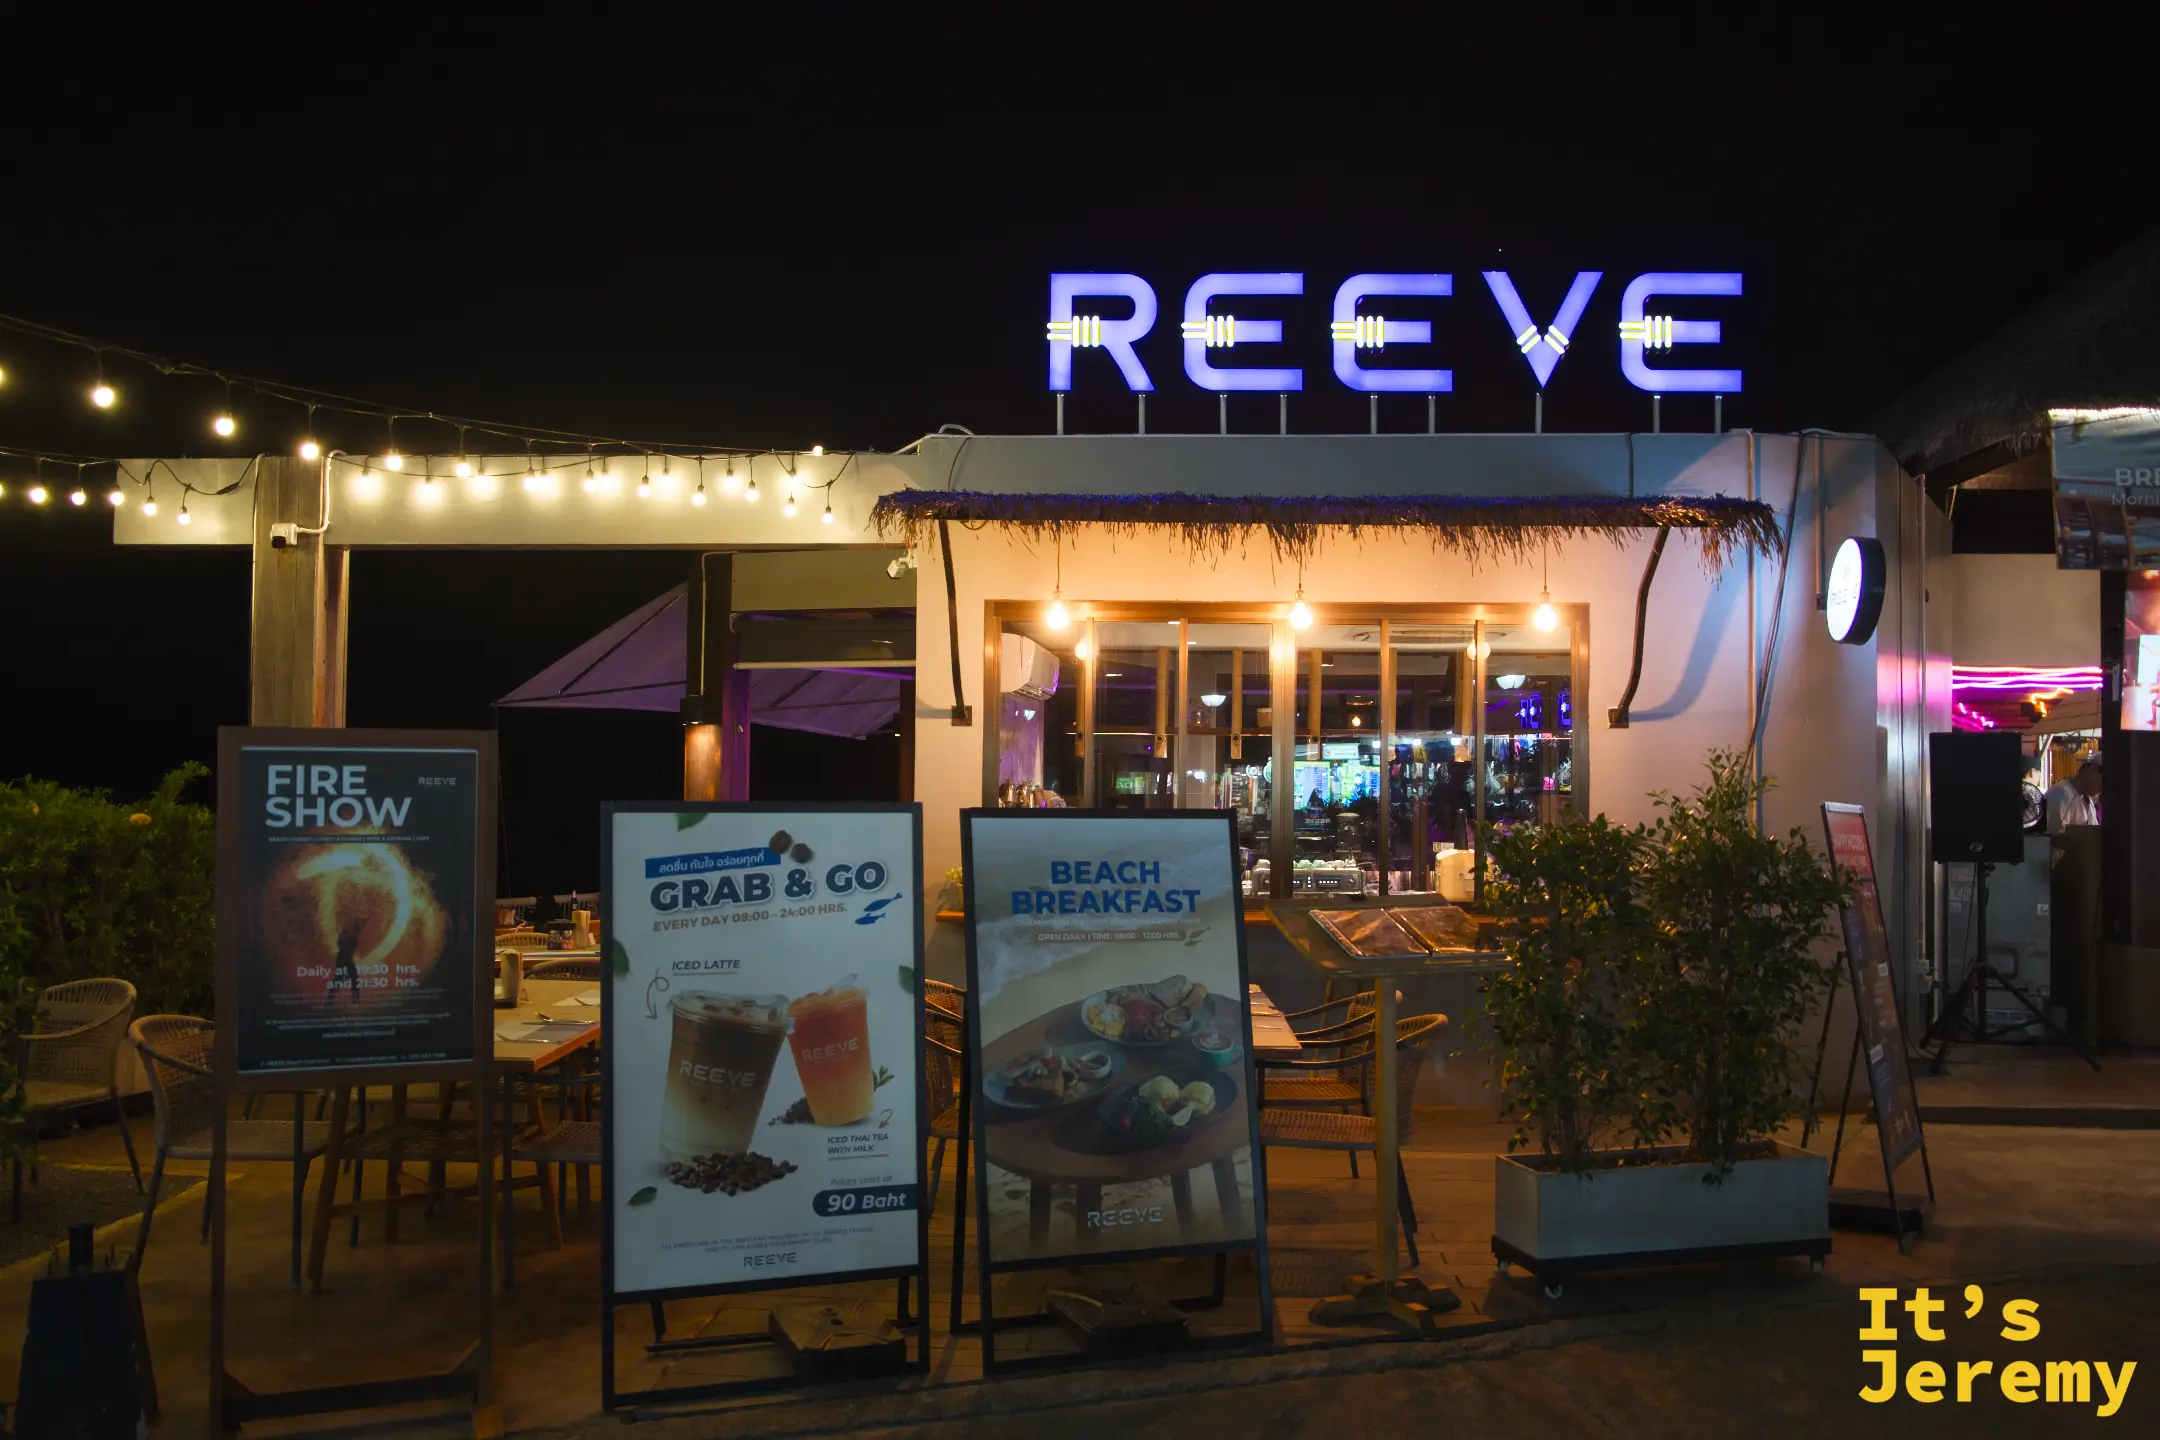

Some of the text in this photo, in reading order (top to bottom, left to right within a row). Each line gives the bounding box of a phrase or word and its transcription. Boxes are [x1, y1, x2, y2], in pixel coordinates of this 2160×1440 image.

[1047, 271, 1743, 392] REEVE
[267, 764, 367, 795] FIRE
[418, 777, 457, 786] REEVE
[265, 797, 412, 828] SHOW
[1050, 860, 1160, 885] BEACH
[649, 860, 887, 913] GRAB & GO
[1011, 889, 1201, 915] BREAKFAST
[653, 917, 698, 932] EVERY
[701, 914, 729, 927] DAY
[732, 910, 770, 923] 08:00
[779, 906, 815, 919] 24:00
[818, 902, 848, 915] HRS.
[1037, 933, 1061, 941] OPEN
[1063, 933, 1086, 941] DAILY
[1091, 932, 1113, 940] TIME:
[1142, 932, 1162, 940] 12:00
[1163, 931, 1181, 939] HRS.
[296, 963, 420, 979] Daily at 19:30 hrs.
[672, 959, 741, 970] ICED LATTE
[326, 977, 420, 990] and 21:30 hrs.
[801, 1037, 859, 1062] REEVE
[679, 1059, 757, 1087] REEVE
[827, 1132, 889, 1144] ICED THAI TEA
[827, 1144, 876, 1154] WITH MILK
[827, 1192, 907, 1212] 90 Baht
[1087, 1205, 1164, 1228] REEVE
[744, 1252, 797, 1268] REEVE
